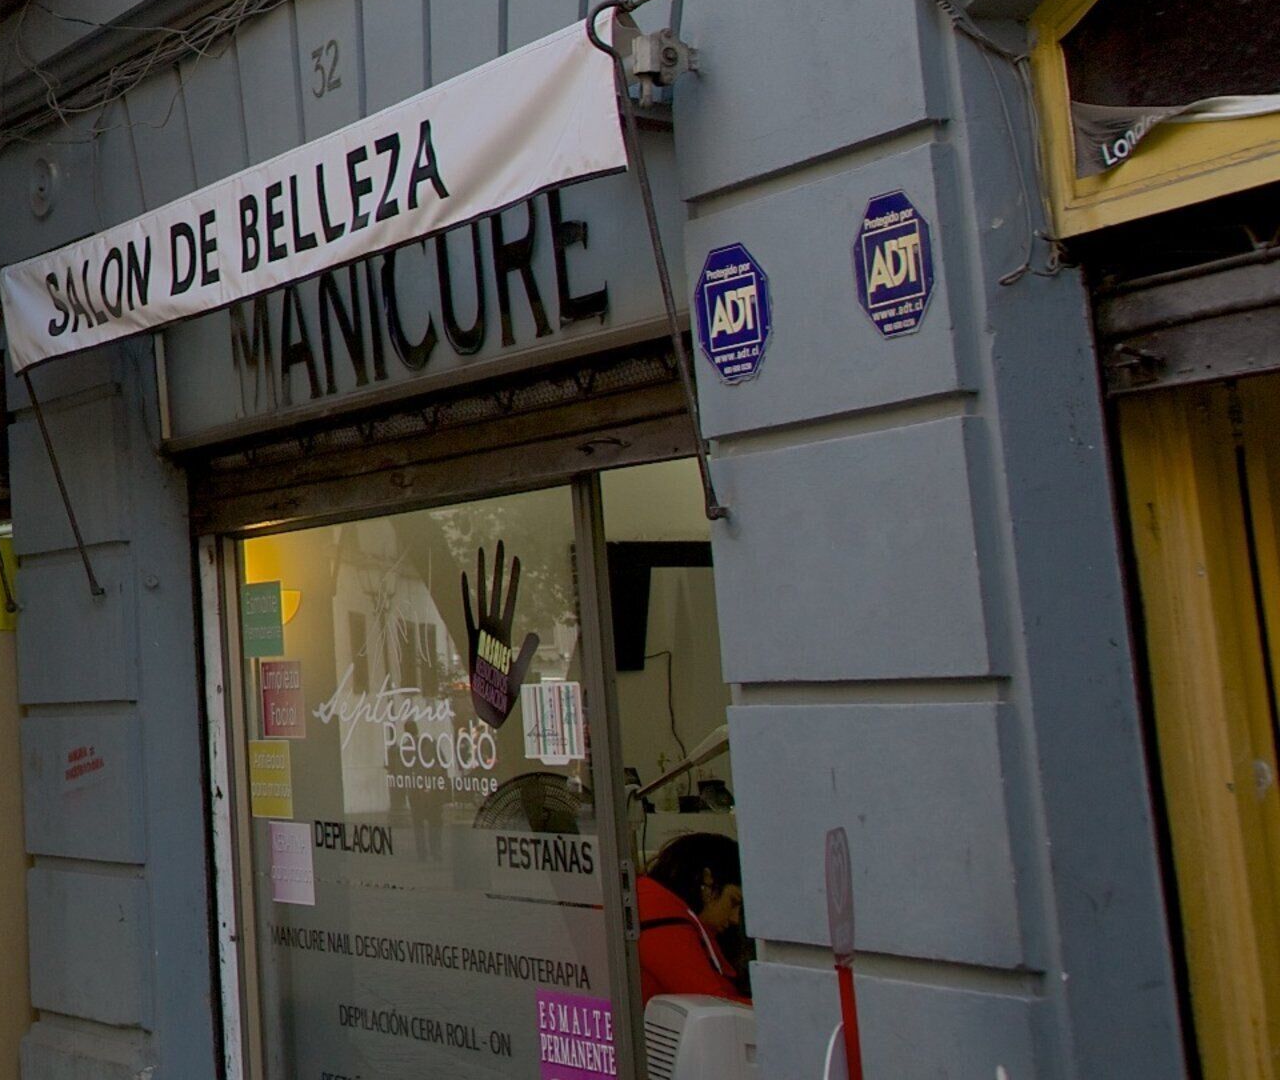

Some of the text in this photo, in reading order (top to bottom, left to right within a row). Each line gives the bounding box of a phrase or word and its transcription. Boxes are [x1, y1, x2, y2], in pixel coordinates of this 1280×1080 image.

[312, 39, 342, 98] 32
[46, 119, 449, 337] SALON DE BELLEZA
[865, 208, 913, 230] Protegido por
[705, 262, 751, 281] Protegido por
[868, 233, 920, 293] ADT
[230, 188, 610, 417] MANICURE
[711, 284, 756, 338] ADT
[872, 298, 923, 321] www.adt.cl
[714, 344, 760, 364] www.adt.cl
[383, 720, 497, 770] Pecado
[385, 773, 498, 797] manicure lounge
[315, 820, 393, 856] DEPILACION
[496, 824, 594, 875] PESTAÑAS
[271, 925, 591, 990] MANICURE NAIL DESIGNS VITRAGE PARAFINOTERAPIA
[340, 1003, 409, 1038] DEPILACIÓN
[411, 1016, 443, 1044] CERA
[446, 1022, 481, 1051] ROLL
[490, 1030, 513, 1057] ON
[538, 1000, 613, 1041] ESMALTE
[540, 1032, 617, 1075] PERMANENTE
